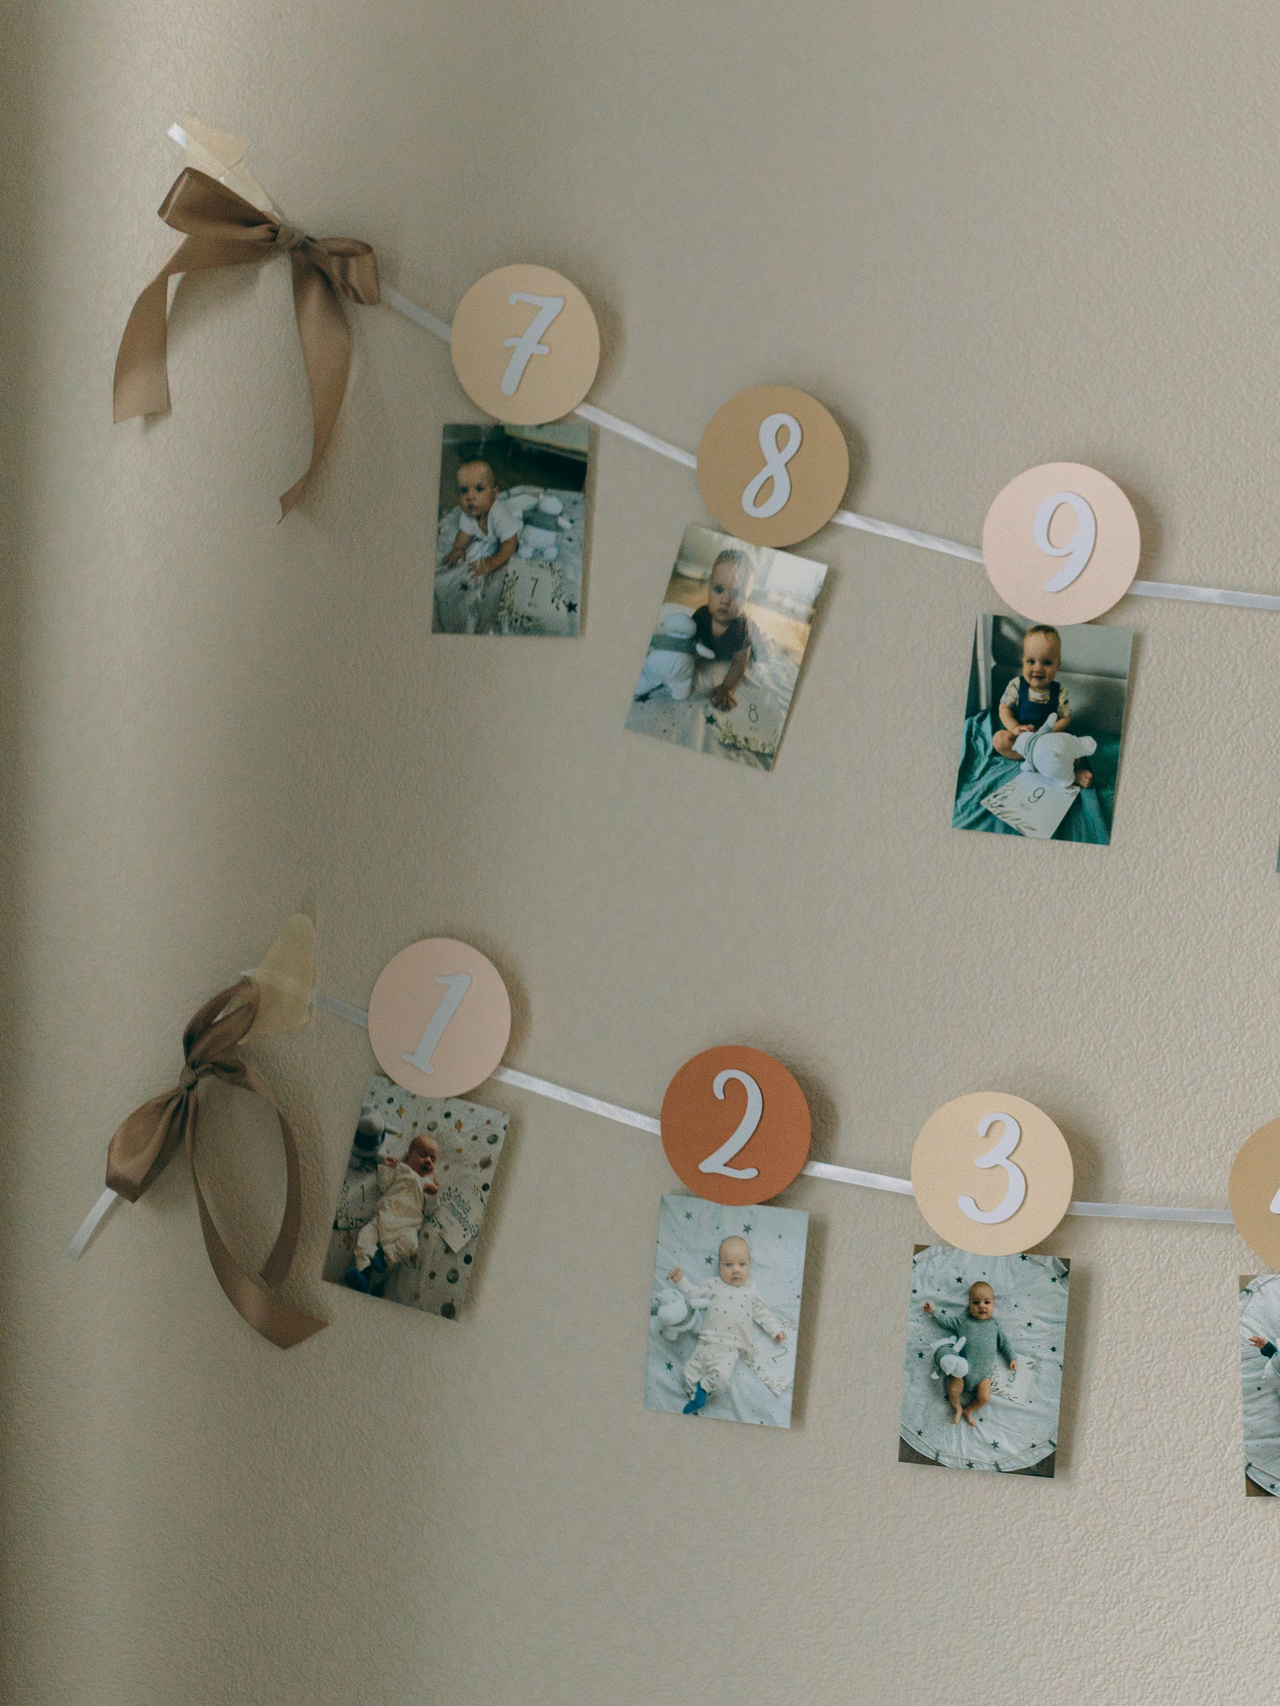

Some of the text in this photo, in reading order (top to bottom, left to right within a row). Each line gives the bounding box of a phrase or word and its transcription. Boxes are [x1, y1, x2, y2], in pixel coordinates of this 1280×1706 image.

[501, 292, 564, 396] 7
[741, 413, 802, 519] 8
[530, 576, 539, 598] 7
[1033, 491, 1096, 593] 9
[748, 702, 759, 723] 8
[1028, 787, 1046, 803] 9
[402, 973, 472, 1075] 1
[699, 1069, 764, 1180] 2
[957, 1112, 1026, 1224] 3
[771, 1346, 788, 1364] 2
